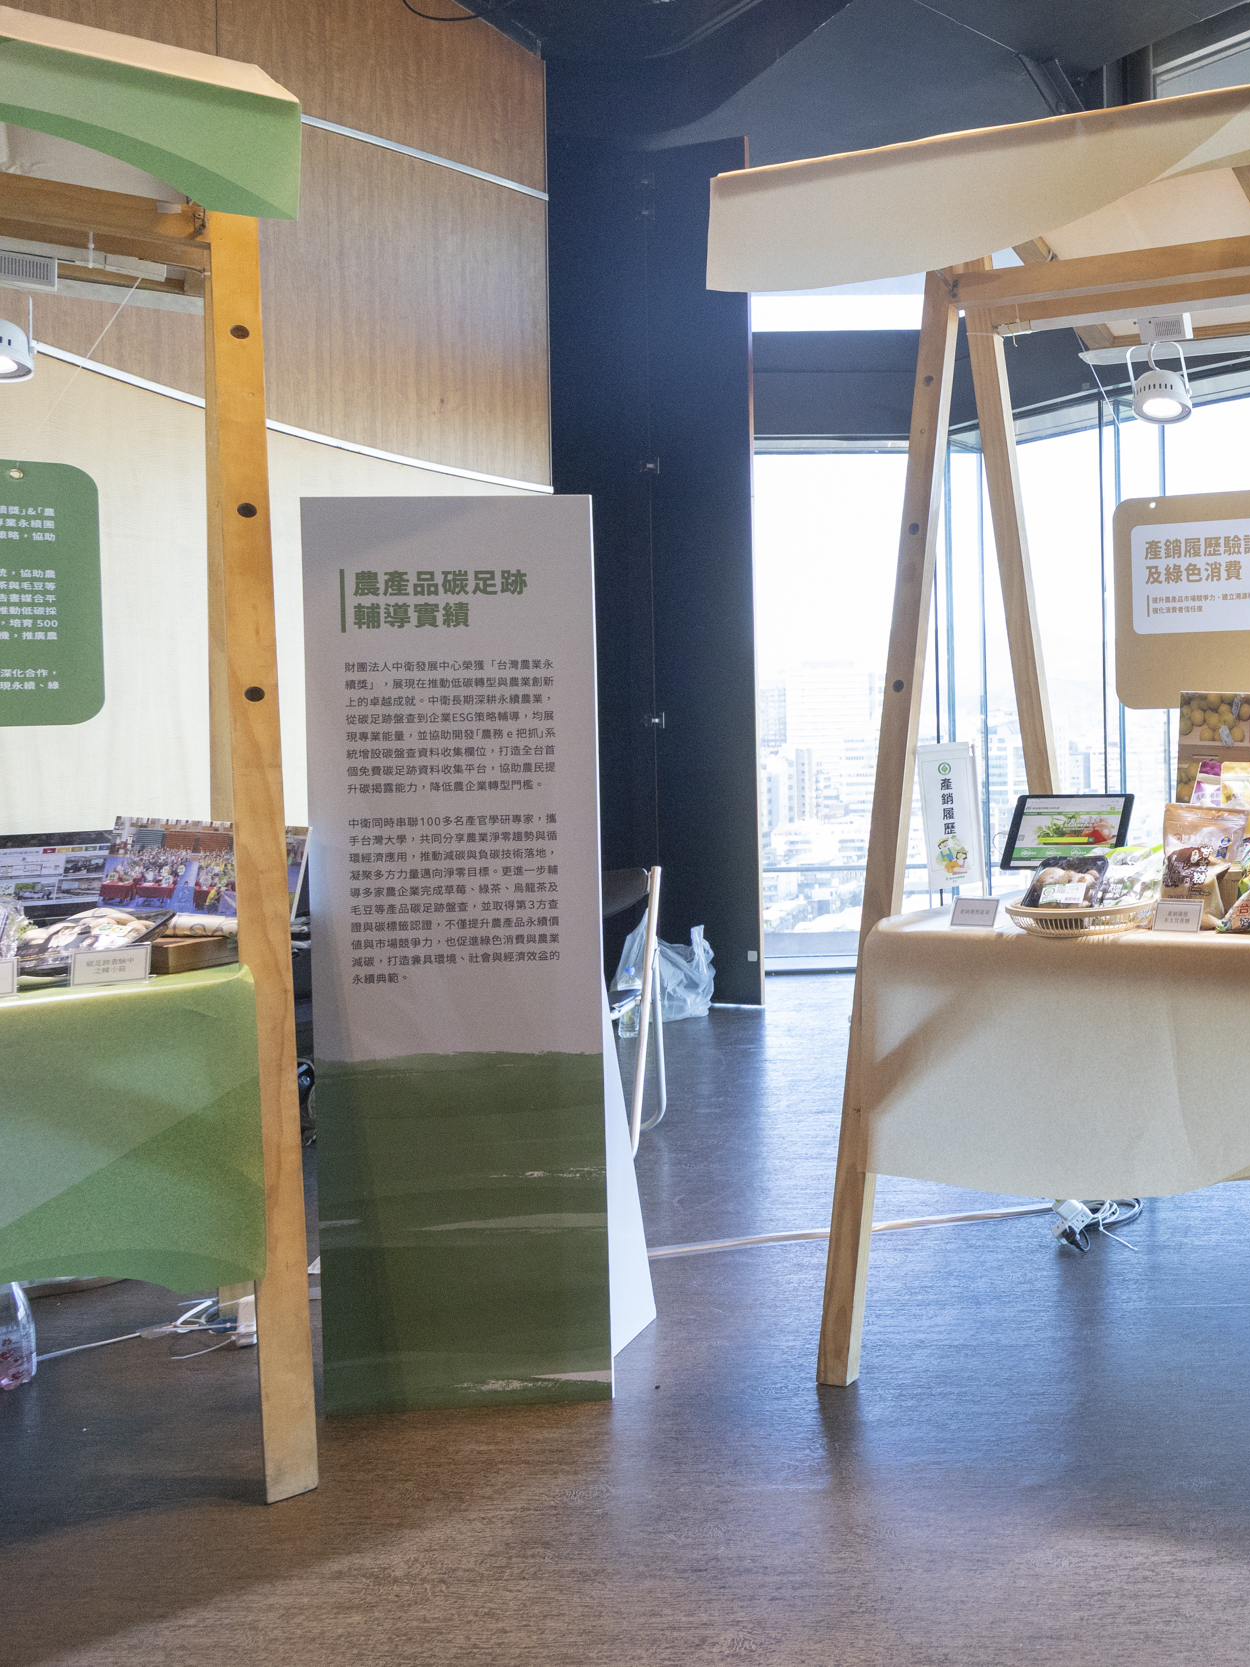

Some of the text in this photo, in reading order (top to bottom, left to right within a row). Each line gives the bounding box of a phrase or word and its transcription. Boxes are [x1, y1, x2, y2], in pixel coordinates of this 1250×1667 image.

[353, 569, 528, 597] 農產品碳足跡
[1144, 560, 1242, 585] 及綠色消費
[36, 619, 58, 628] 500
[353, 602, 470, 629] 輔導實績
[344, 658, 554, 673] 財團法人中衛發展中心榮獲「台灣農業永
[940, 778, 956, 835] 產銷履歷
[352, 972, 408, 985] 永續典範。
